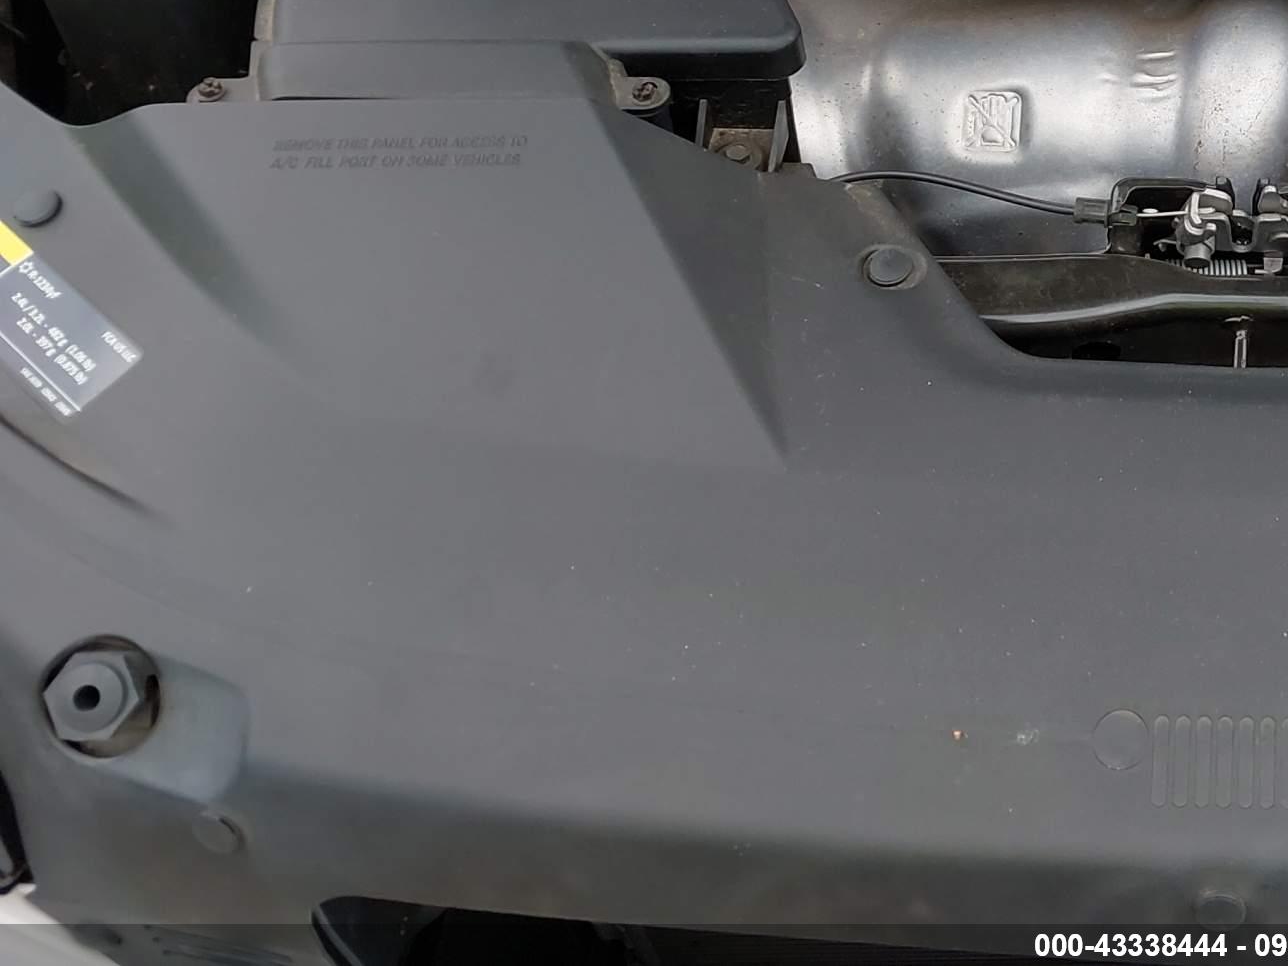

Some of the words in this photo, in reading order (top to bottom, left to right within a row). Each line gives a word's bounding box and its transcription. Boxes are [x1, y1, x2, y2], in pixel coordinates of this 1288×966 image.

[371, 137, 416, 149] PANEL
[419, 136, 449, 149] FOR
[510, 134, 528, 147] TO
[270, 155, 299, 169] A/C
[304, 155, 334, 169] FILL
[339, 154, 377, 169] PORT
[381, 154, 404, 167] ON
[407, 153, 449, 167] SOME
[454, 153, 521, 166] VEHICLES
